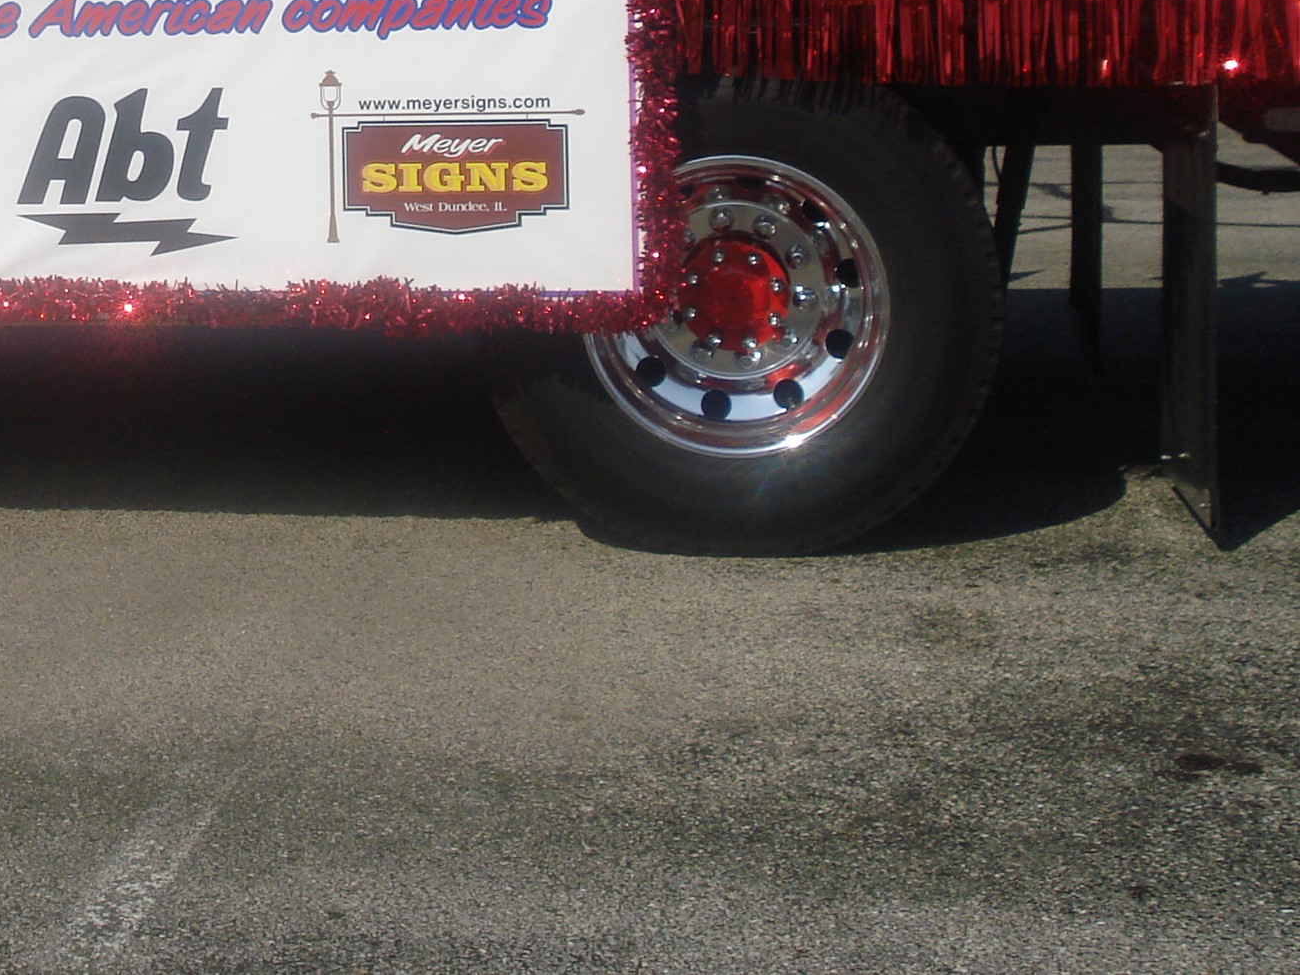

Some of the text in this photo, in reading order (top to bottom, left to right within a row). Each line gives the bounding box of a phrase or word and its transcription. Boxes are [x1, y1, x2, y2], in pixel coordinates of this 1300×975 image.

[358, 95, 550, 111] www.meyersigns.com
[17, 87, 229, 205] Abt
[401, 133, 506, 158] Meyer
[361, 161, 549, 194] SIGNS
[404, 202, 433, 212] West
[494, 201, 507, 212] IL
